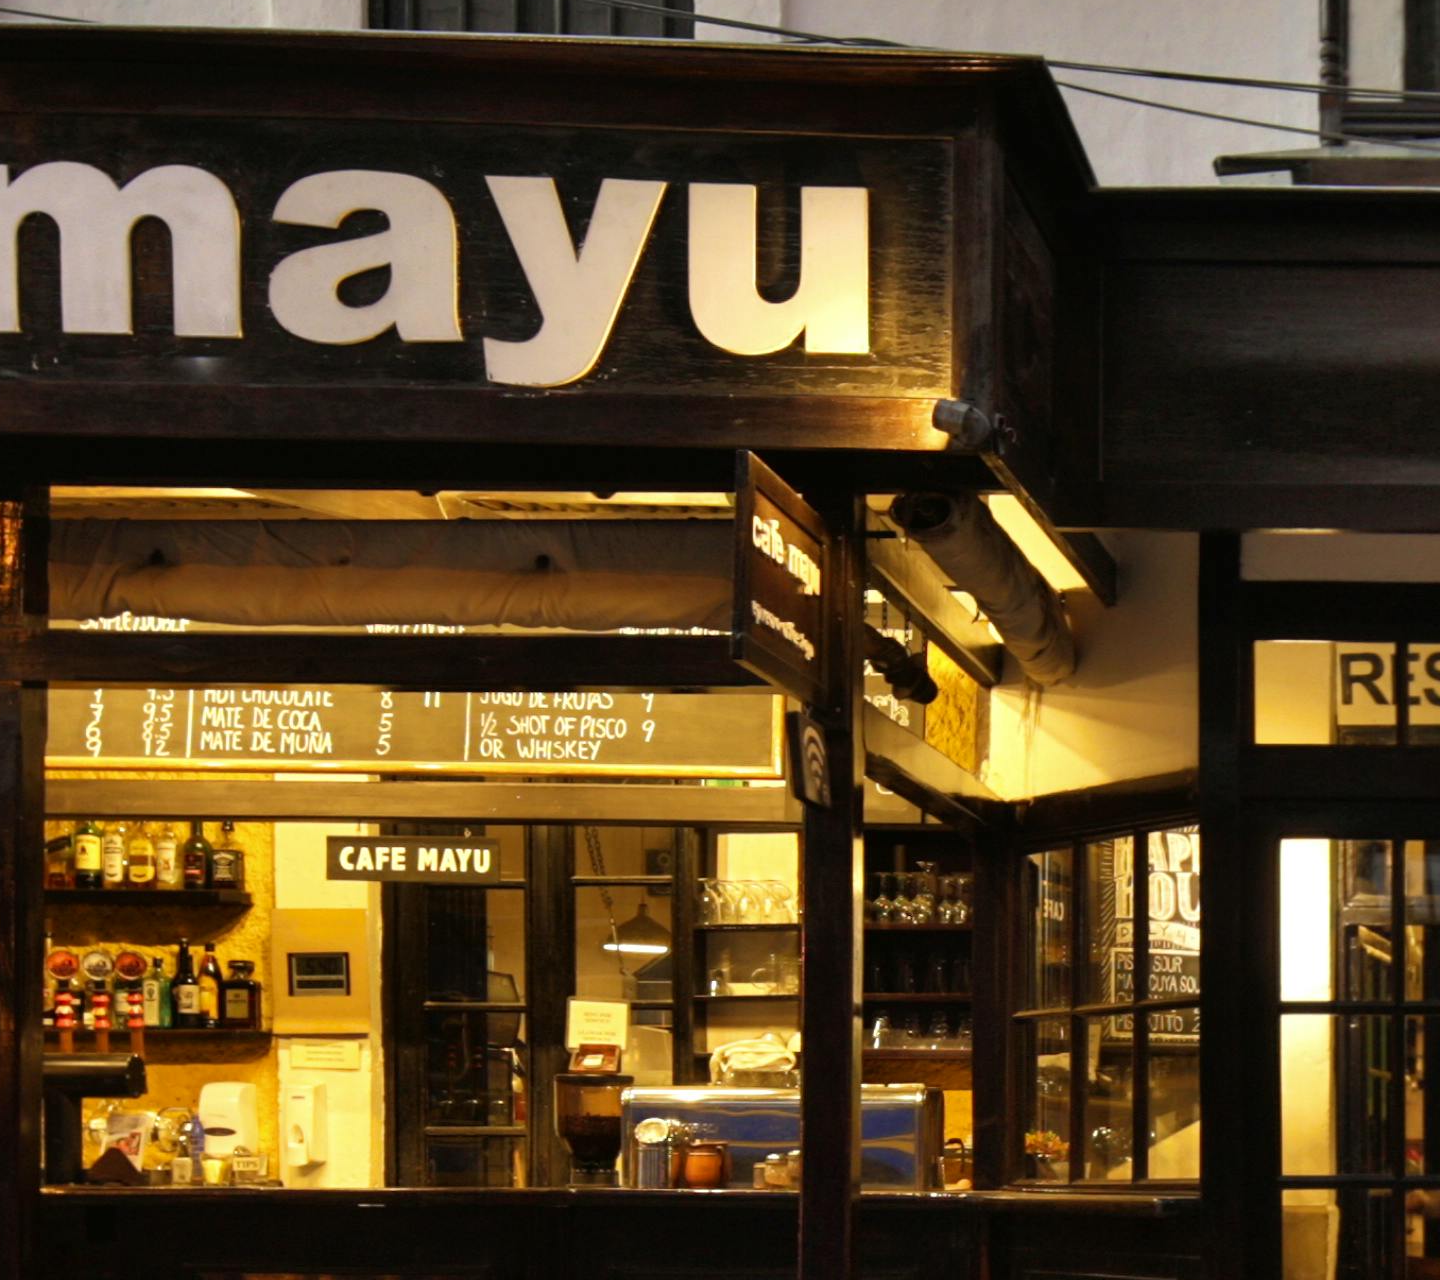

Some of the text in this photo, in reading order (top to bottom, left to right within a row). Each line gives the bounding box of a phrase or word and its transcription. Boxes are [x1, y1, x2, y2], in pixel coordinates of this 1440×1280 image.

[753, 515, 784, 564] cafe
[143, 702, 174, 722] 9.5
[202, 706, 395, 733] MATE DE COCA 5
[86, 720, 101, 740] 6
[506, 714, 551, 736] SHOT
[554, 716, 577, 738] OF
[580, 715, 628, 740] PISCO
[642, 719, 656, 743] 9
[85, 739, 102, 758] 9
[144, 739, 171, 757] 12
[200, 730, 392, 756] MATE DE MUÑA 5
[479, 738, 602, 761] OR WHISKEY
[339, 846, 491, 874] CAFE MAYU
[1114, 831, 1200, 877] HAP
[1115, 872, 1200, 922] HOU
[1152, 955, 1183, 973] SOUR
[1117, 972, 1177, 993] MACUYA
